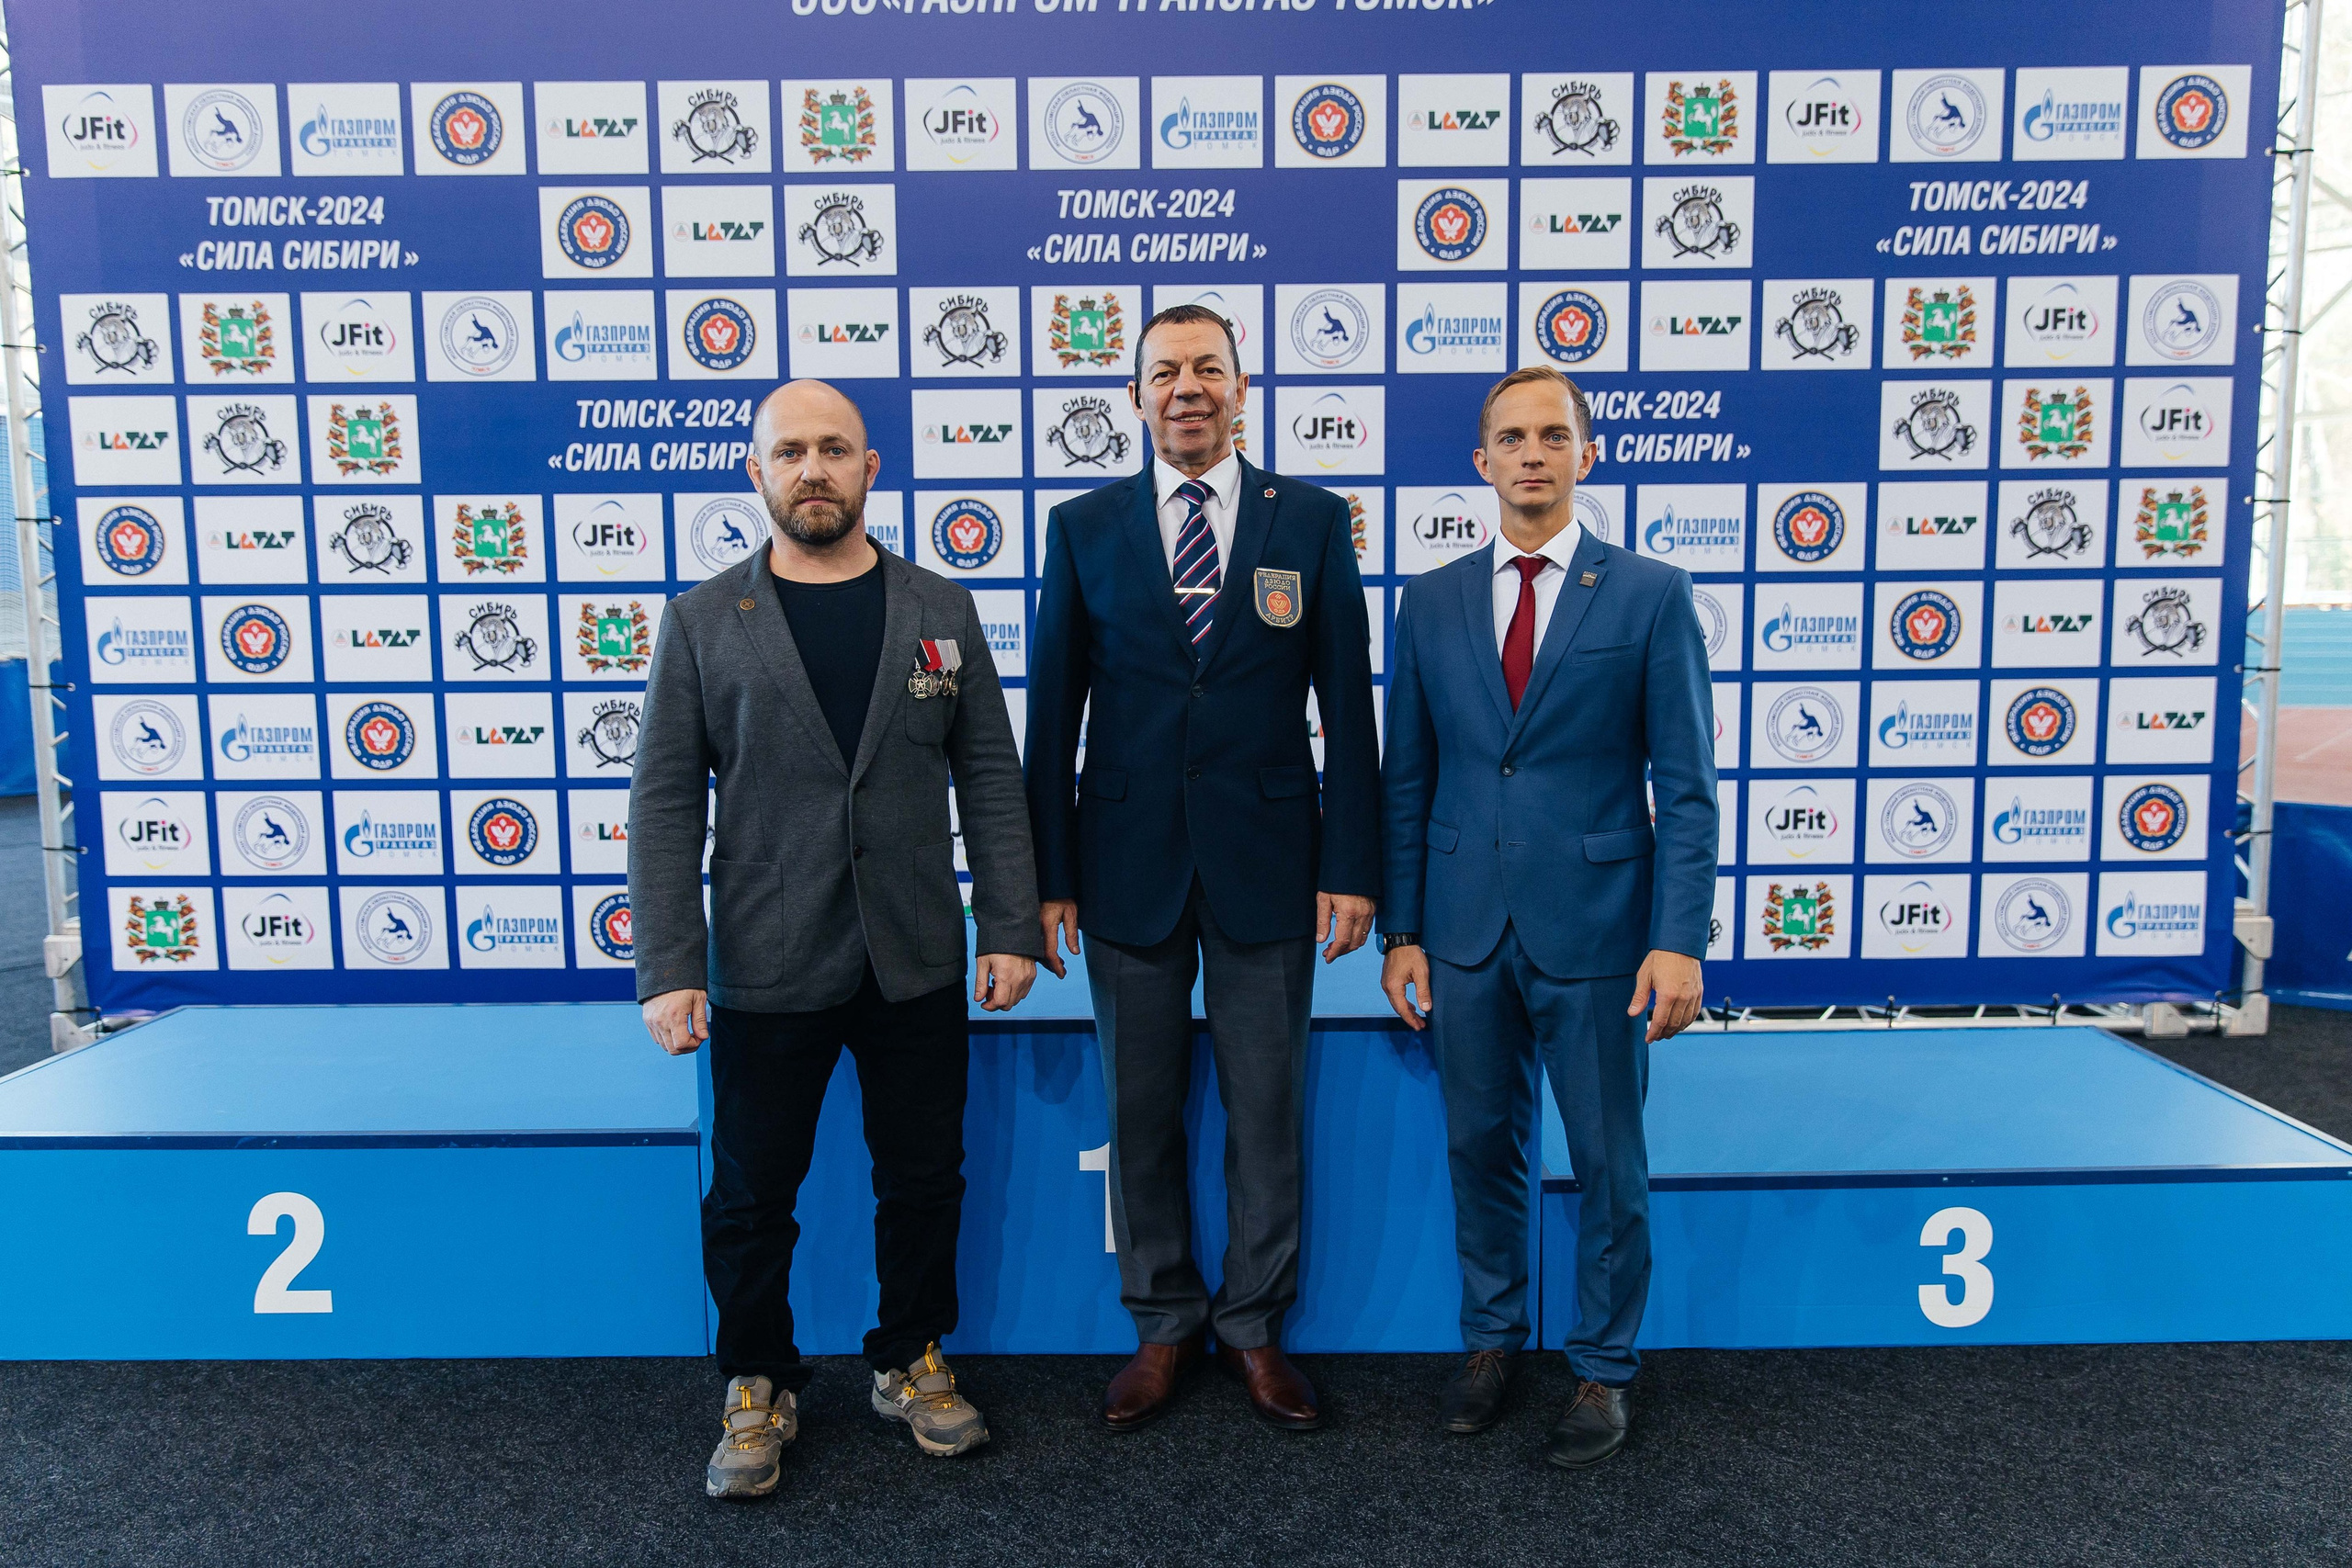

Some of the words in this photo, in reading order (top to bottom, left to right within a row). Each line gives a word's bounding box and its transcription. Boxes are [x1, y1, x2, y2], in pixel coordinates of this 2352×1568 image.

[686, 87, 738, 107] СИБИРЬ
[1551, 80, 1601, 100] СИБИРЬ
[1193, 110, 1258, 128] ГАЗПРОМ
[1294, 88, 1320, 144] ФЕДЕРАЦИЯ
[1322, 85, 1356, 106] ДЗЮДО
[1349, 104, 1363, 143] РОССИИ
[1795, 100, 1849, 127] JFit
[2055, 102, 2120, 119] ГАЗПРОМ
[73, 115, 126, 141] JFit
[331, 118, 396, 135] ГАЗПРОМ
[432, 95, 458, 151] ФЕДЕРАЦИЯ
[458, 93, 492, 113] ДЗЮДО
[487, 111, 501, 151] РОССИИ
[933, 108, 987, 135] JFit
[1193, 130, 1258, 141] ТРАНСГАЗ
[1193, 141, 1258, 150] ТОМСК
[1317, 145, 1340, 157] ФДР
[456, 152, 481, 164] ФДР
[814, 192, 865, 211] СИБИРЬ
[1672, 184, 1723, 204] СИБИРЬ
[1909, 179, 2089, 212] ТОМСК-2024
[206, 196, 385, 226] ТОМСК-2024
[1057, 188, 1236, 220] ТОМСК-2024
[1416, 192, 1442, 247] ФЕДЕРАЦИЯ
[1443, 189, 1477, 209] ДЗЮДО
[1470, 208, 1484, 246] РОССИИ
[1026, 233, 1122, 264] «СИЛА
[1130, 232, 1268, 263] СИБИРИ»
[1875, 225, 1972, 256] «СИЛА
[1979, 223, 2119, 255] СИБИРИ»
[178, 240, 274, 271] «СИЛА
[282, 239, 420, 271] СИБИРИ»
[1438, 249, 1462, 260] ФДР
[938, 294, 989, 313] СИБИРЬ
[1791, 287, 1842, 306] СИБИРЬ
[89, 301, 139, 321] СИБИРЬ
[2034, 307, 2086, 333] JFit
[330, 321, 383, 347] JFit
[586, 324, 650, 342] ГАЗПРОМ
[686, 302, 712, 356] ФЕДЕРАЦИЯ
[712, 299, 746, 320] ДЗЮДО
[740, 318, 754, 356] РОССИИ
[1437, 316, 1501, 333] ГАЗПРОМ
[587, 344, 650, 353] ТРАНСГАЗ
[1437, 336, 1501, 345] ТРАНСГАЗ
[709, 358, 733, 369] ФДР
[1060, 394, 1112, 413] СИБИРЬ
[1583, 390, 1722, 421] МСК-2024
[1909, 387, 1959, 406] СИБИРЬ
[216, 402, 266, 421] СИБИРЬ
[576, 399, 752, 429] ТОМСК-2024
[2150, 408, 2201, 433] JFit
[1303, 416, 1355, 442] JFit
[548, 442, 641, 472] «СИЛА
[650, 441, 755, 471] СИБИР
[1615, 433, 1752, 463] СИБИРИ»
[2027, 488, 2076, 506] СИБИРЬ
[344, 502, 393, 521] СИБИРЬ
[1775, 496, 1801, 548] ФЕДЕРАЦИЯ
[1802, 492, 1835, 512] ДЗЮДО
[1827, 510, 1841, 547] РОССИИ
[582, 523, 635, 547] JFit
[933, 503, 959, 556] ФЕДЕРАЦИЯ
[959, 501, 993, 520] ДЗЮДО
[986, 518, 1001, 556] РОССИИ
[1422, 515, 1475, 541] JFit
[1676, 518, 1739, 535] ГАЗПРОМ
[1676, 537, 1739, 547] ТРАНСГАЗ
[956, 558, 979, 568] ФДР
[1795, 550, 1819, 561] ФДР
[1258, 571, 1296, 581] ФЕДЕРАЦИЯ
[2141, 586, 2190, 604] СИБИРЬ
[468, 601, 517, 619] СИБИРЬ
[1265, 613, 1294, 624] АРБИТР
[981, 624, 1020, 639] ПРОМ
[1793, 616, 1856, 633] ГАЗПРОМ
[126, 629, 187, 646] ГАЗПРОМ
[1792, 635, 1856, 644] ТРАНСГАЗ
[592, 699, 641, 716] СИБИРЬ
[1909, 713, 1972, 728] ГАЗПРОМ
[250, 727, 312, 743] ГАЗПРОМ
[347, 705, 373, 757] ФЕДЕРАЦИЯ
[372, 704, 405, 722] ДЗЮДО
[400, 720, 413, 756] РОССИИ
[1908, 731, 1972, 739] ТРАНСГАЗ
[370, 758, 394, 768] ФДР
[1775, 807, 1826, 830] JFit
[2022, 808, 2085, 824] ГАЗПРОМ
[130, 819, 179, 843] JFit
[374, 822, 435, 839] ГАЗПРОМ
[470, 803, 496, 852] ФЕДЕРАЦИЯ
[496, 800, 528, 818] ДЗЮДО
[523, 817, 537, 852] РОССИИ
[375, 840, 436, 849] ТРАНСГАЗ
[493, 854, 516, 864] ФДР
[1890, 903, 1940, 926] JFit
[2138, 903, 2199, 919] ГАЗПРОМ
[252, 914, 302, 937] JFit
[497, 918, 558, 933] ГАЗПРОМ
[498, 935, 559, 943] ТРАНСГАЗ
[247, 1191, 333, 1313] 2
[1918, 1206, 1994, 1328] 3
